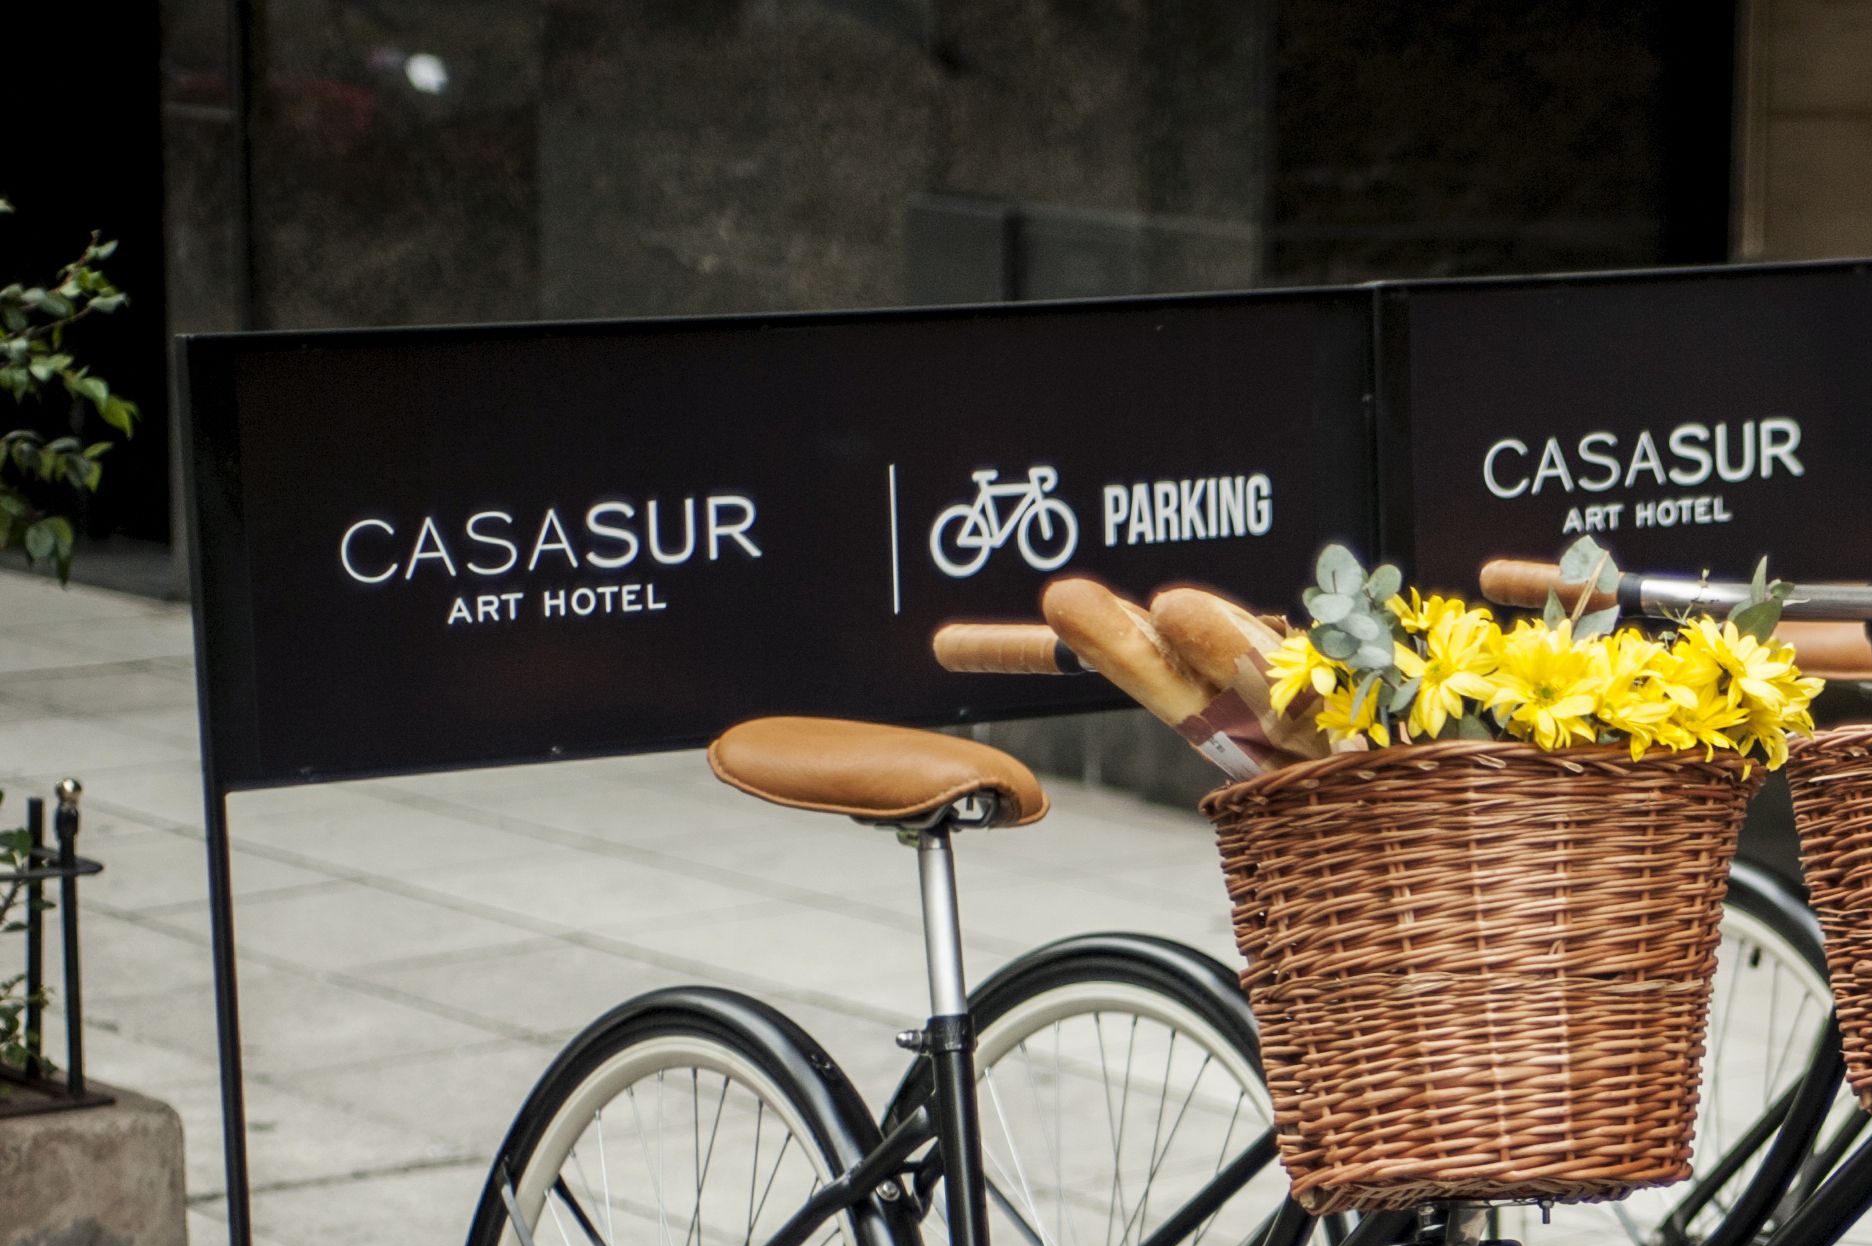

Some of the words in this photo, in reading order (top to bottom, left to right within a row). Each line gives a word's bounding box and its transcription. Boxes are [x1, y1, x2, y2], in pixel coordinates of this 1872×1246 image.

[1482, 417, 1805, 500] CASASUR
[339, 495, 762, 584] CASASUR
[1102, 473, 1273, 547] PARKING
[1562, 503, 1624, 534] ART
[1636, 495, 1732, 528] HOTEL
[447, 592, 524, 625] ART
[543, 583, 667, 618] HOTEL
